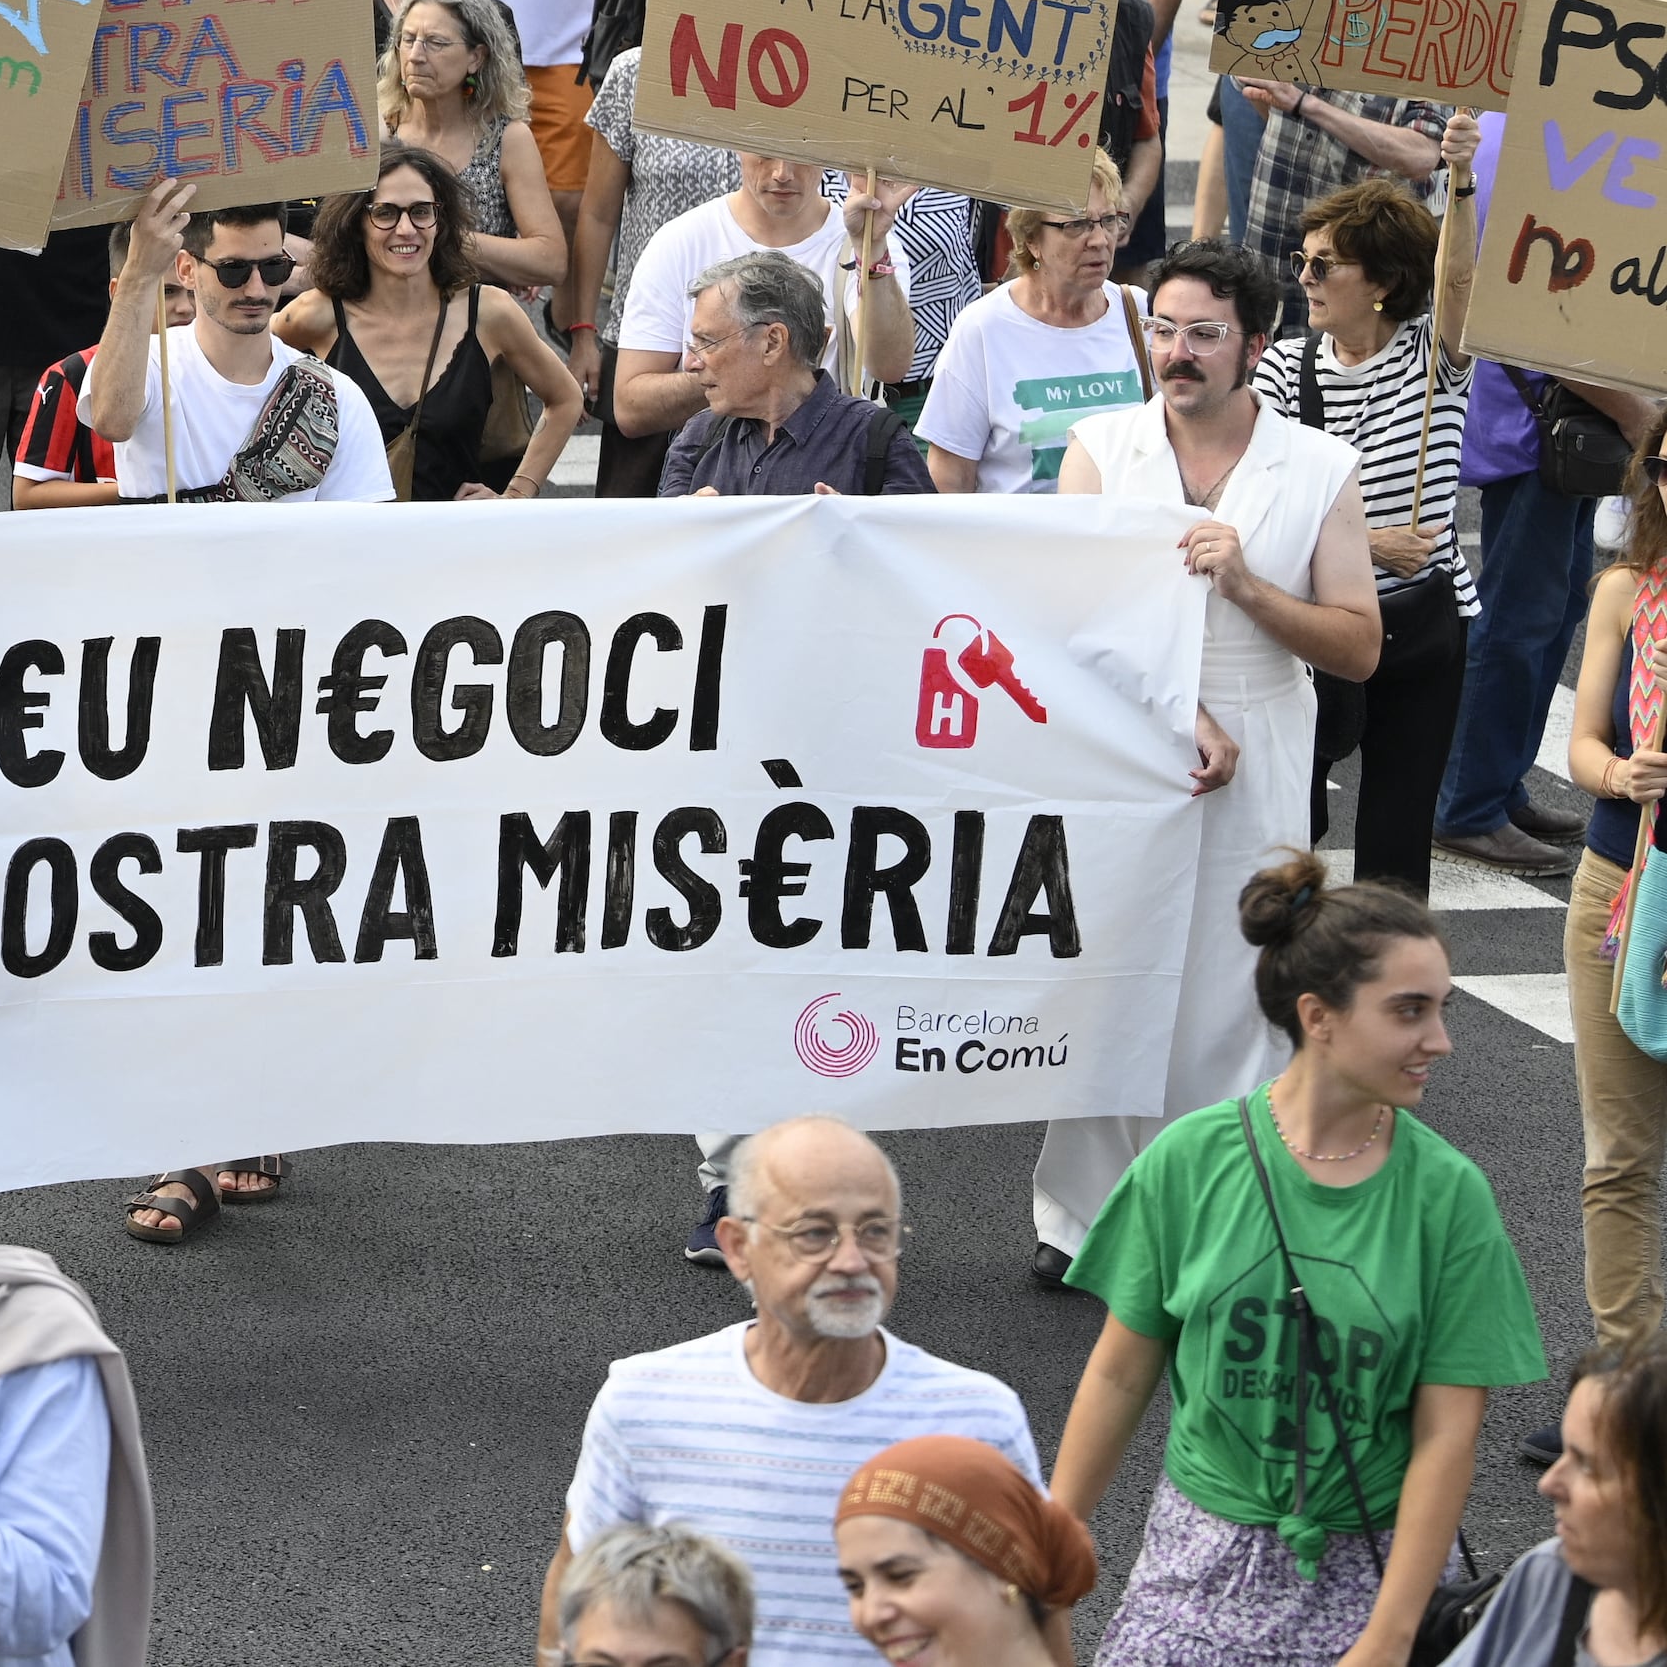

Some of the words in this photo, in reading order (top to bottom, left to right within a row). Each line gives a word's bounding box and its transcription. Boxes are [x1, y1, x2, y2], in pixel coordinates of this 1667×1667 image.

[90, 13, 245, 99] TRA
[668, 13, 810, 112] NO
[840, 75, 910, 116] PER
[1007, 81, 1094, 153] 1%
[57, 57, 377, 200] ISERIA
[1045, 386, 1072, 404] My
[895, 1039, 947, 1074] En
[954, 1032, 1069, 1074] Comú
[896, 1004, 1040, 1035] Barcelona
[1223, 1296, 1384, 1388] STOP
